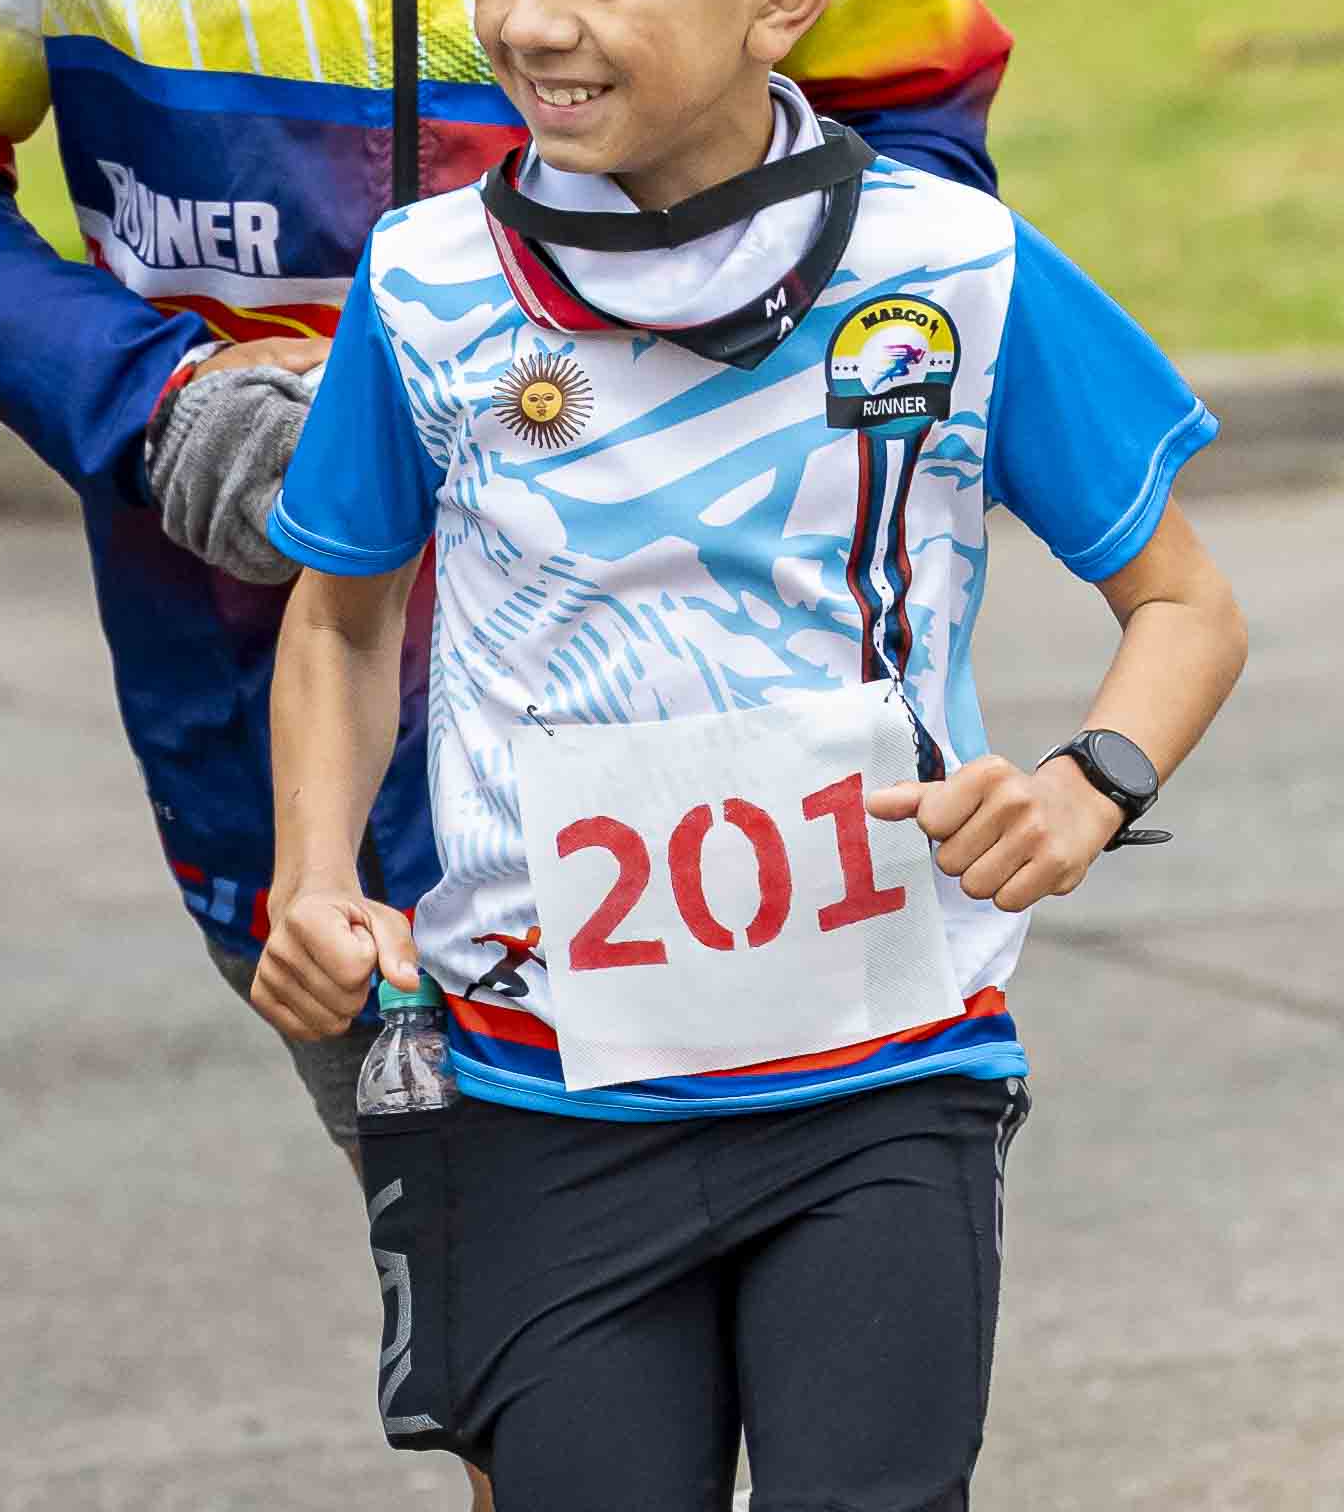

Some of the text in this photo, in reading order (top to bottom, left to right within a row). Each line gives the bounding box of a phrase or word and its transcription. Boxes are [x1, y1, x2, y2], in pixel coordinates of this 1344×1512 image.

[96, 159, 282, 276] RUNNER
[860, 307, 929, 330] MARCO
[862, 395, 928, 417] RUNNER
[555, 771, 907, 971] 201
